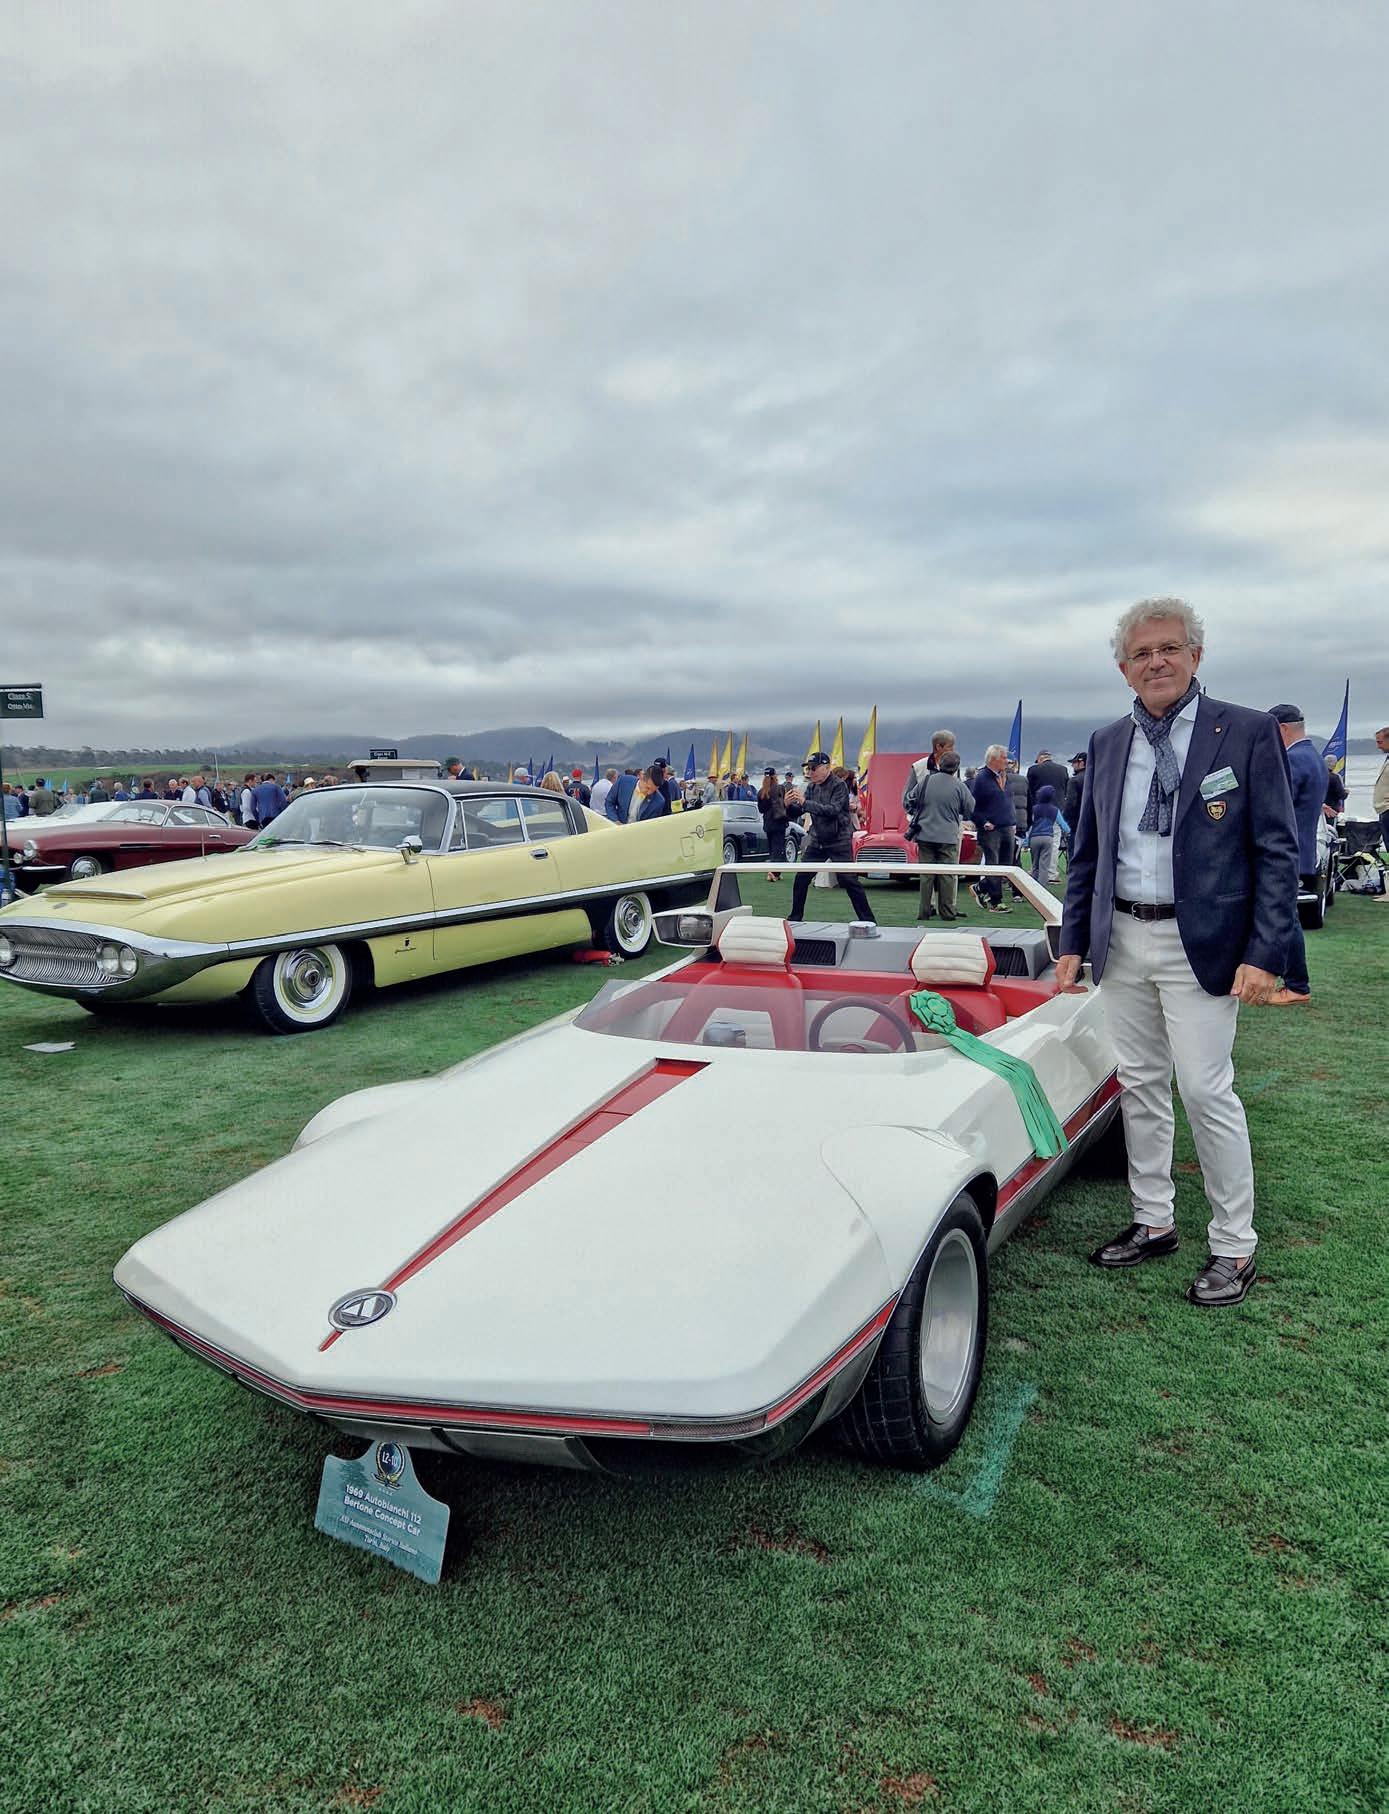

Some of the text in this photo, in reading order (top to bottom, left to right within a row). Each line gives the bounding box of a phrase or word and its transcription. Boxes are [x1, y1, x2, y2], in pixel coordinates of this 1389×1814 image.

[344, 1496, 421, 1537] Bertone Concept Car
[345, 1485, 363, 1498] 1969
[364, 1494, 408, 1518] Autobianchi
[410, 1512, 421, 1524] 112
